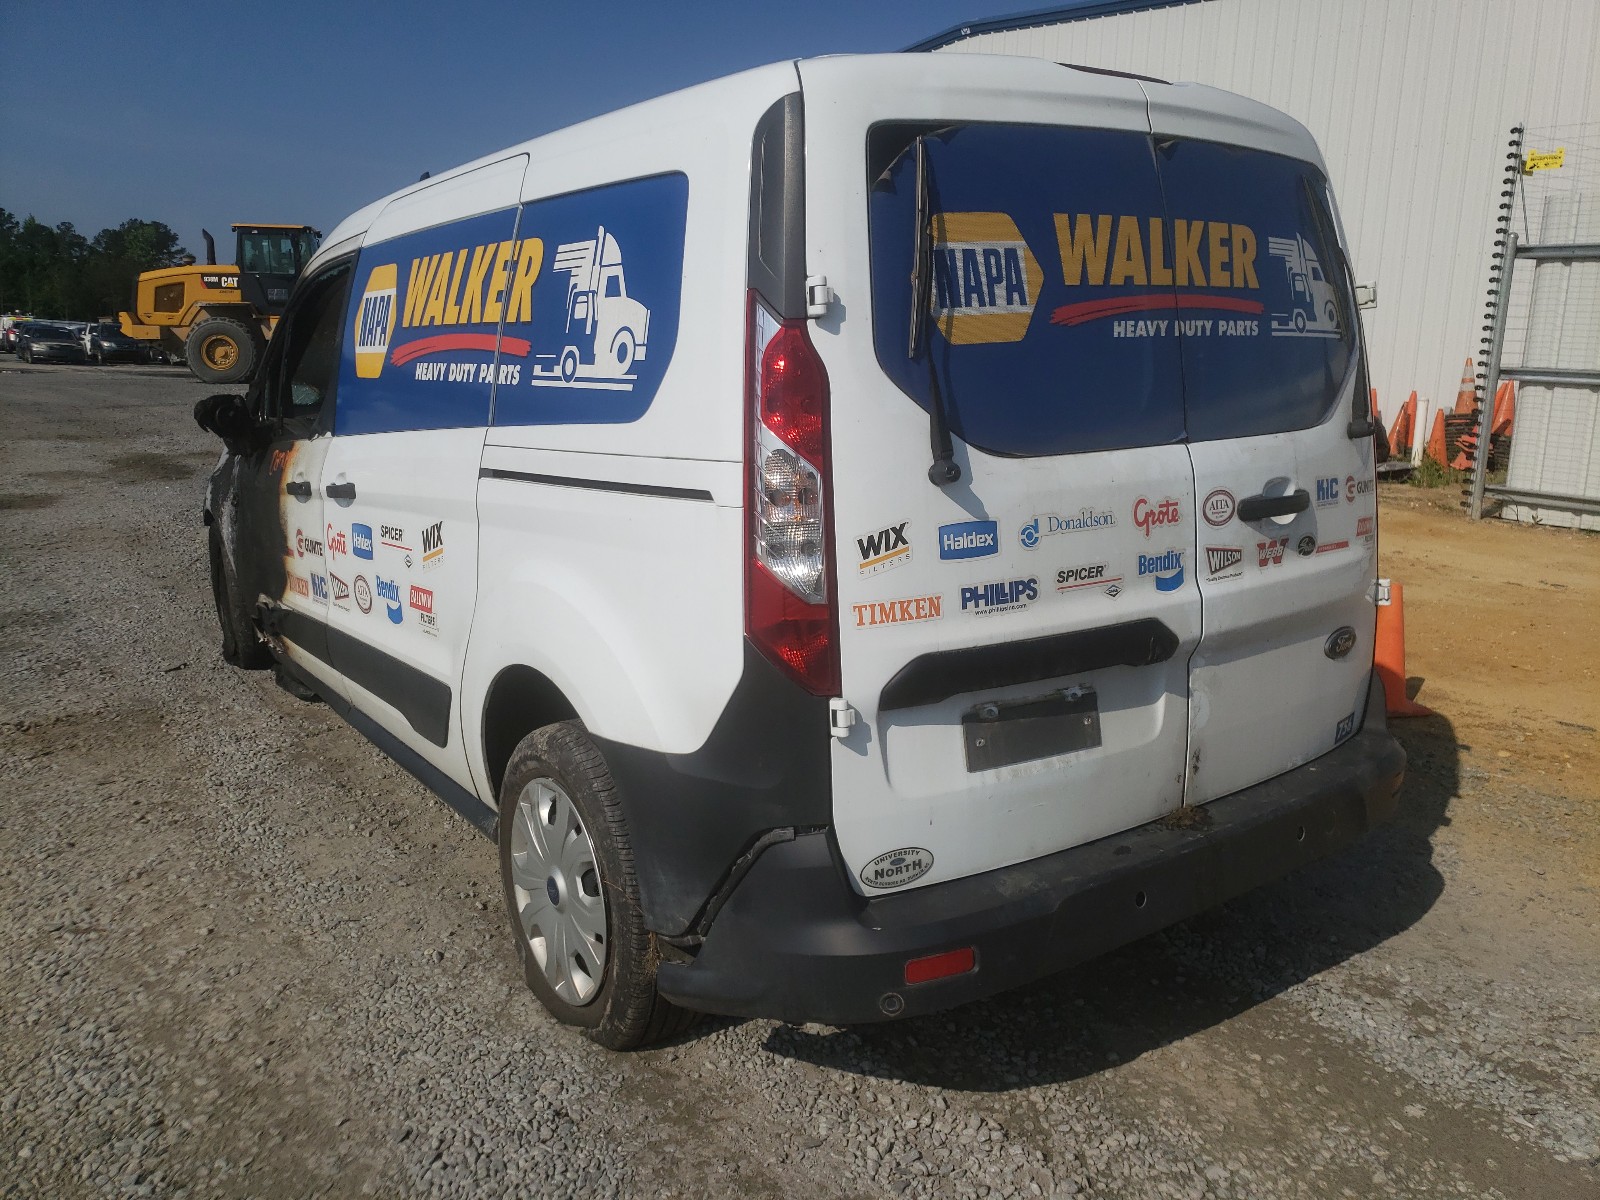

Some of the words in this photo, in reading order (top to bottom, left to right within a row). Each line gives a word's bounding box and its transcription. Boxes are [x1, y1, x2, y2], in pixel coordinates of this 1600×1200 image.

[1053, 213, 1260, 289] WALKER
[221, 277, 238, 287] CAT
[402, 237, 544, 328] WALKER
[934, 246, 1027, 309] NAPA
[358, 294, 392, 347] NAPA
[1113, 320, 1169, 338] HEAVY
[1175, 320, 1213, 337] DUTY
[1218, 320, 1260, 337] PARTS
[415, 362, 447, 381] HEAVY
[448, 363, 477, 383] DUTY
[478, 364, 521, 386] PARTS
[1048, 511, 1114, 533] Donaldson
[1133, 498, 1180, 537] Grote
[353, 532, 372, 551] Haldex
[380, 525, 403, 542] SPICER
[422, 520, 443, 553] WIX
[857, 521, 909, 561] WIX
[943, 532, 994, 551] Haldex
[1138, 551, 1183, 576] Bendix
[1208, 550, 1241, 572] WILSON
[1259, 545, 1284, 560] WEBB
[1056, 565, 1105, 584] SPICER
[376, 574, 401, 604] Bendix
[960, 578, 1038, 610] PHILLIPS
[853, 595, 942, 627] TIMKEN
[874, 849, 921, 866] UNIVERSITY
[874, 859, 922, 880] NORTH
